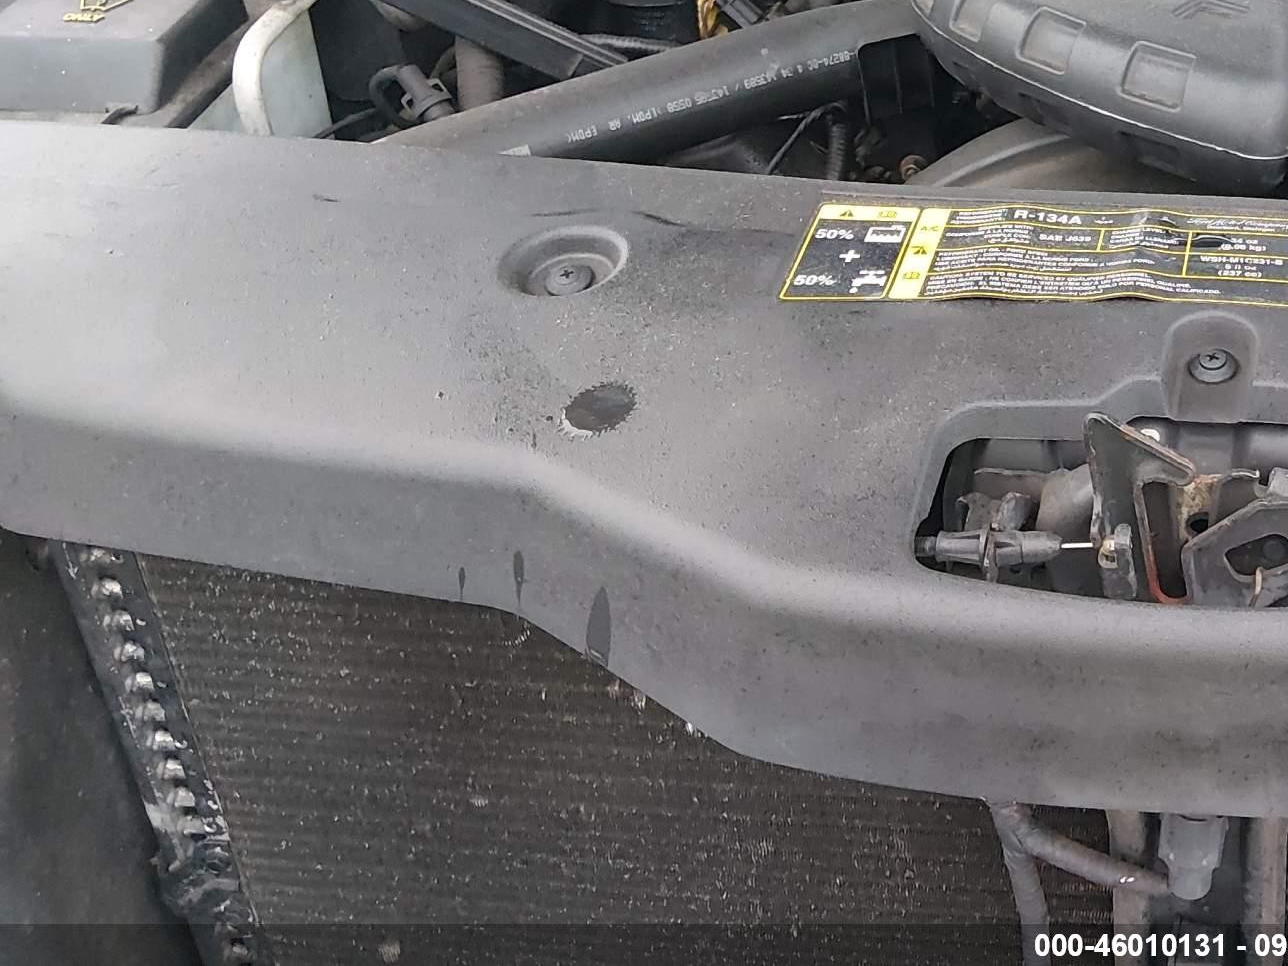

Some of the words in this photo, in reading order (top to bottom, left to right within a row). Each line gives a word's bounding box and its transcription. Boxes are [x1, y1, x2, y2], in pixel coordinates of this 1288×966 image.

[62, 13, 106, 24] ONLY
[1014, 209, 1083, 225] R-134A
[814, 228, 855, 240] 50%
[793, 274, 836, 286] 50%
